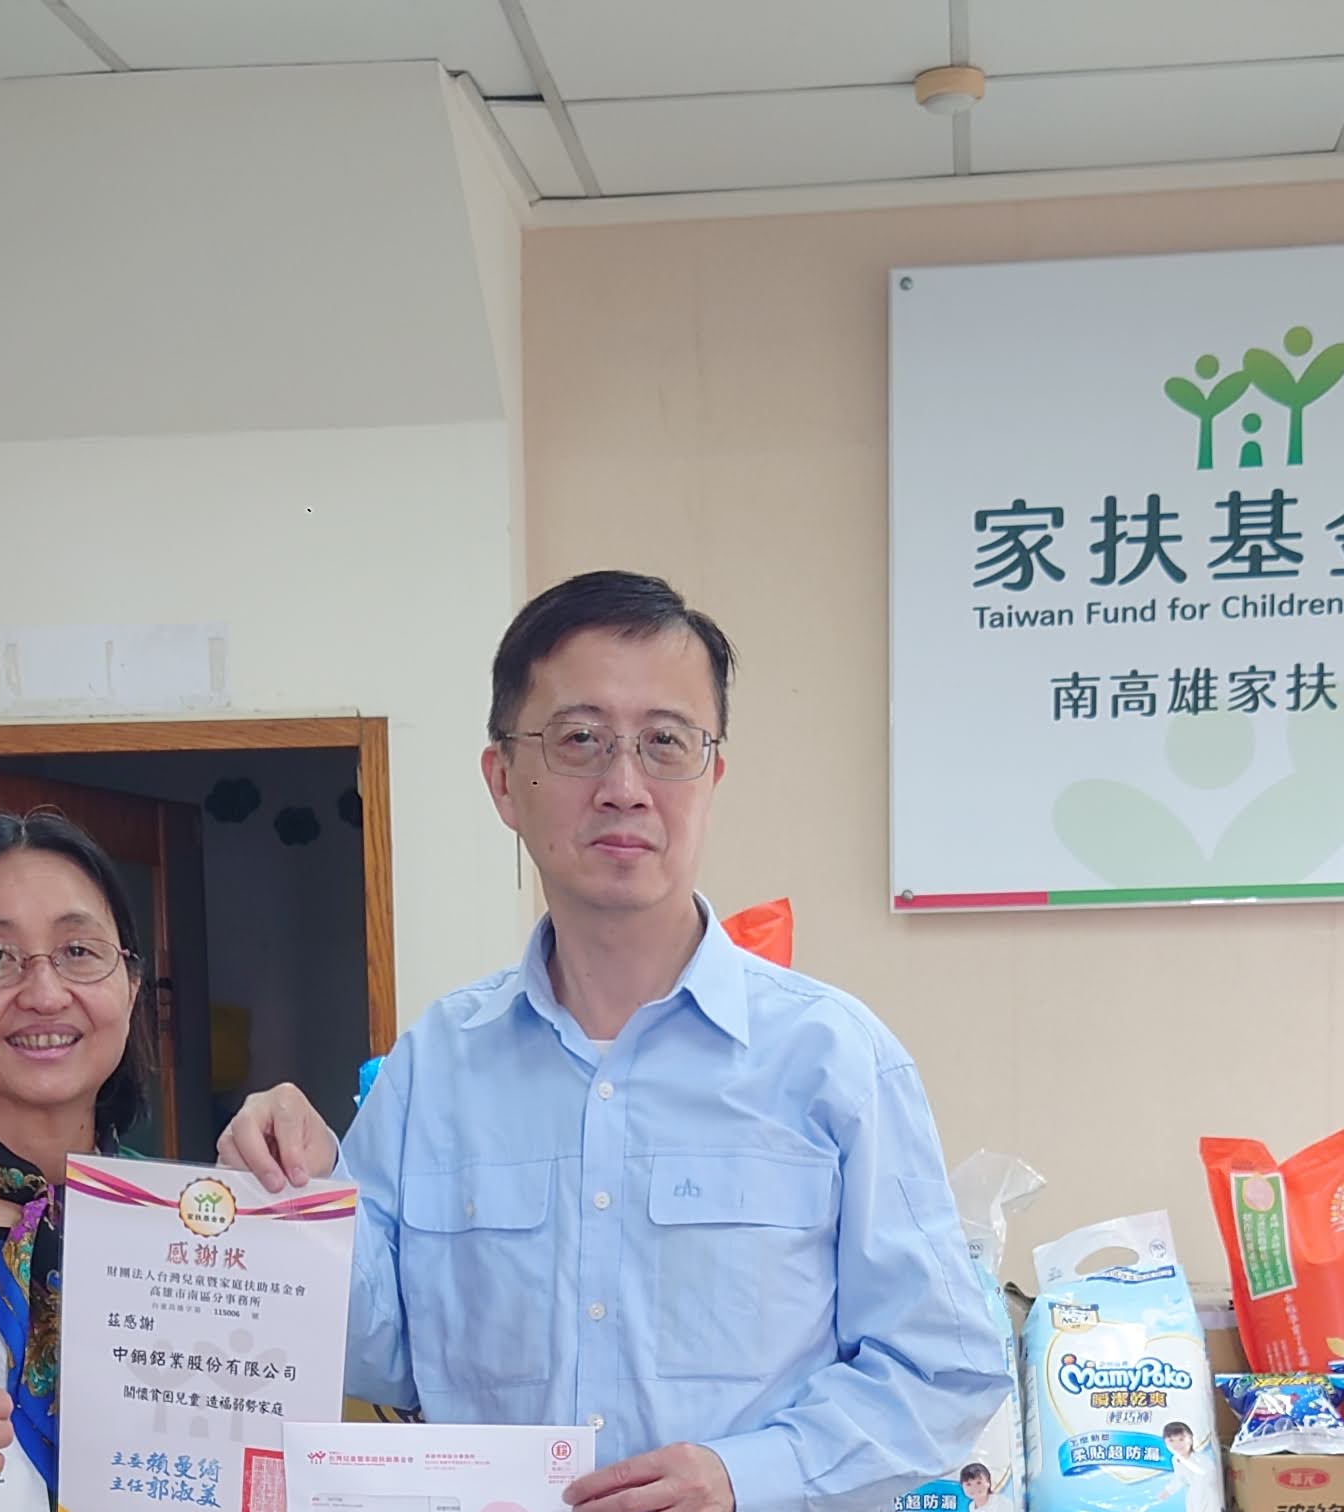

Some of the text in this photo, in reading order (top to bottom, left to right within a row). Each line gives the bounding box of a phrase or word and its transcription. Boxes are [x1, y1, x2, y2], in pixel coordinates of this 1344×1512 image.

[973, 602, 1074, 630] Taiwan
[1085, 599, 1157, 625] Fund
[1168, 596, 1211, 621] for
[1221, 592, 1344, 620] Children
[166, 1240, 247, 1272] 感謝狀
[106, 1265, 306, 1297] 財團法人台灣兒童暨家庭扶助基金會
[149, 1286, 262, 1308] 高雄市南區分事務所
[214, 1308, 241, 1318] 115006
[112, 1346, 298, 1382] 中鋼鋁業股份有限公司
[1058, 1356, 1193, 1395] MamyPoko
[206, 1395, 285, 1417] 造福弱勢家庭
[1071, 1446, 1162, 1463] 柔貼超防漏
